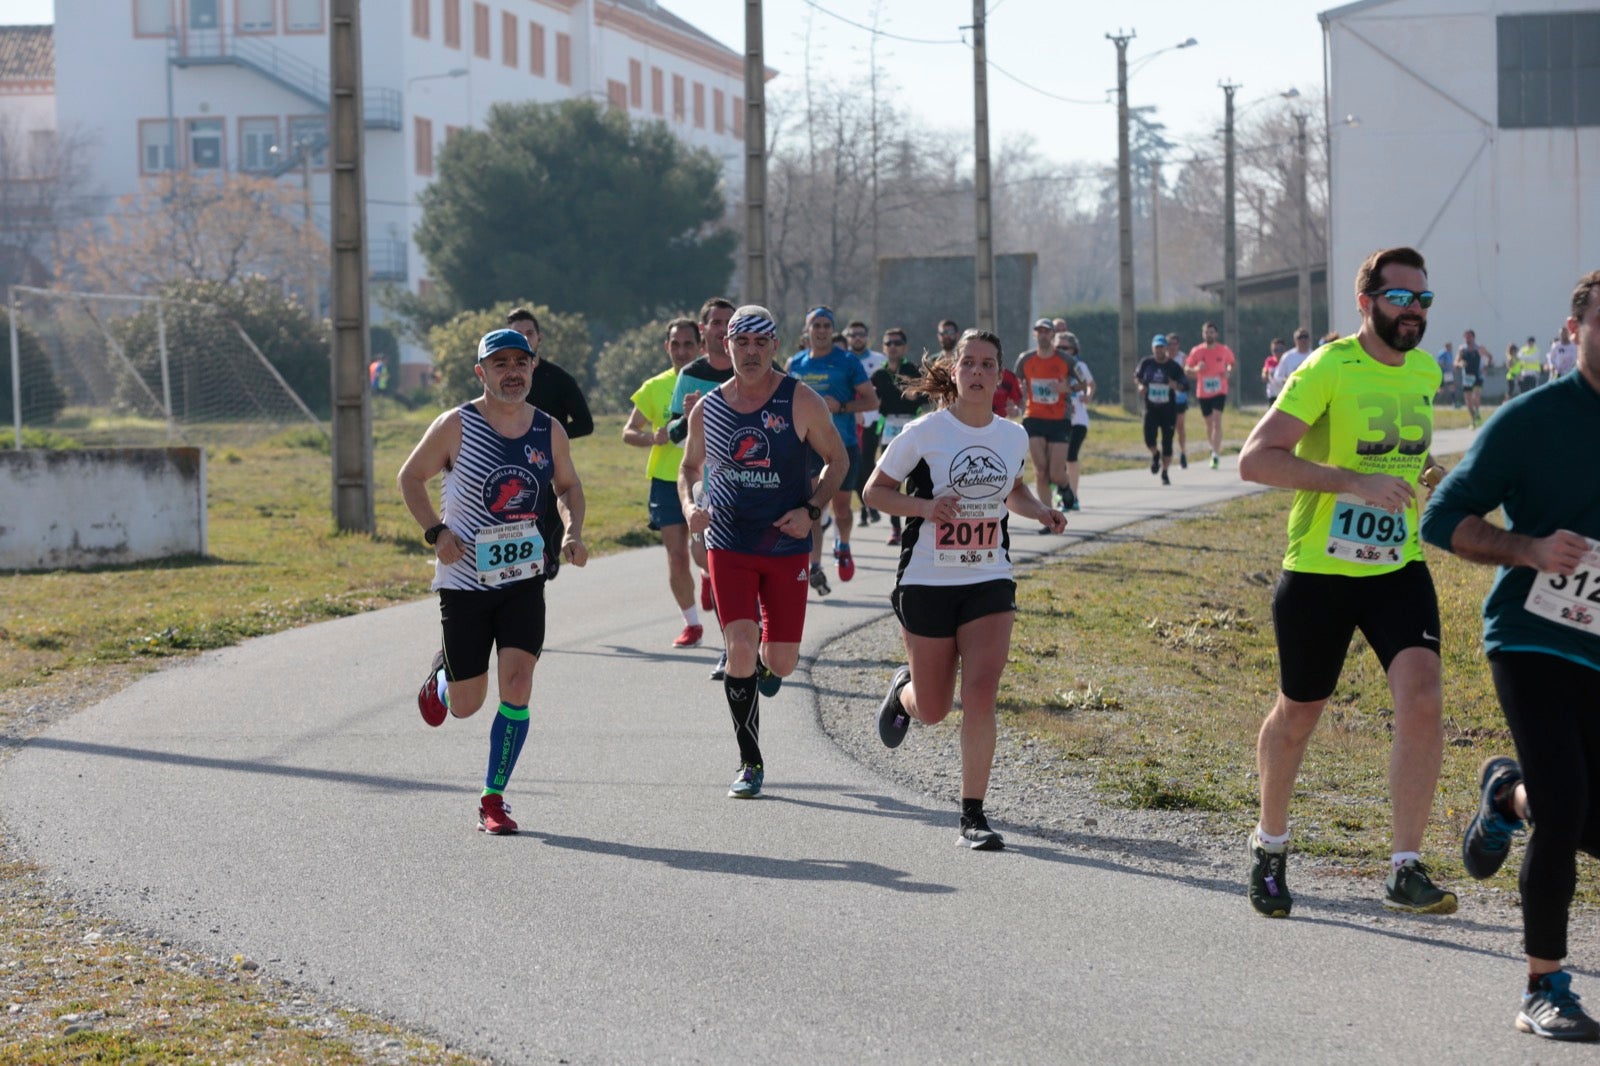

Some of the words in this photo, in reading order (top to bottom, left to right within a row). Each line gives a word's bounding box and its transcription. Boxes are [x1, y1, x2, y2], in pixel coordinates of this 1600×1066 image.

[1356, 392, 1432, 455] 35
[491, 469, 517, 484] HUELLAS
[939, 522, 997, 546] 2017
[489, 541, 534, 566] 388
